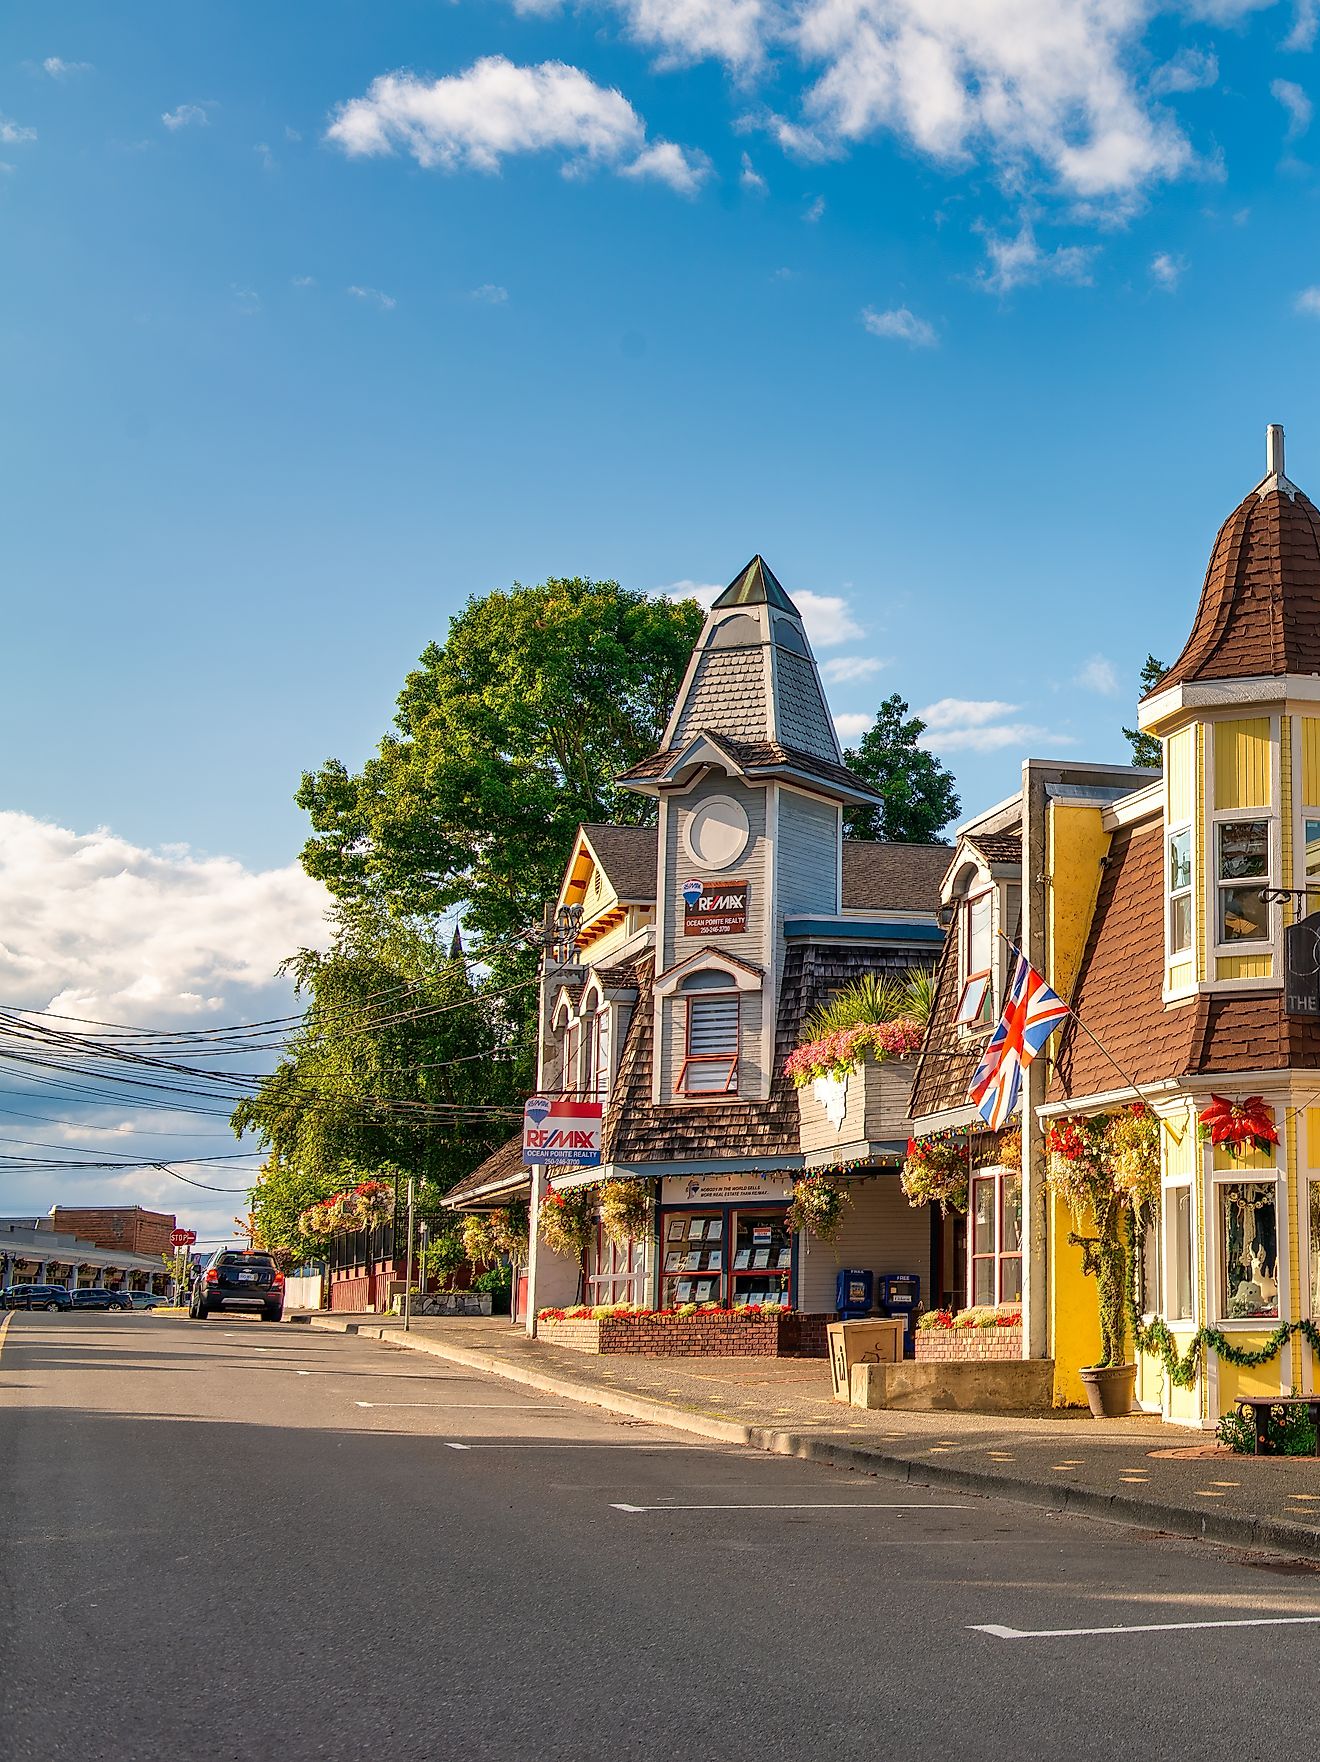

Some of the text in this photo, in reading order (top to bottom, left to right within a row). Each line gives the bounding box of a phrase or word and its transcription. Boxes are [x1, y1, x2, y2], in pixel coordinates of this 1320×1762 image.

[699, 895, 744, 911] RE/MAX
[705, 918, 724, 926] POINTE
[1288, 995, 1316, 1011] THE
[527, 1129, 595, 1148] RE/MAX
